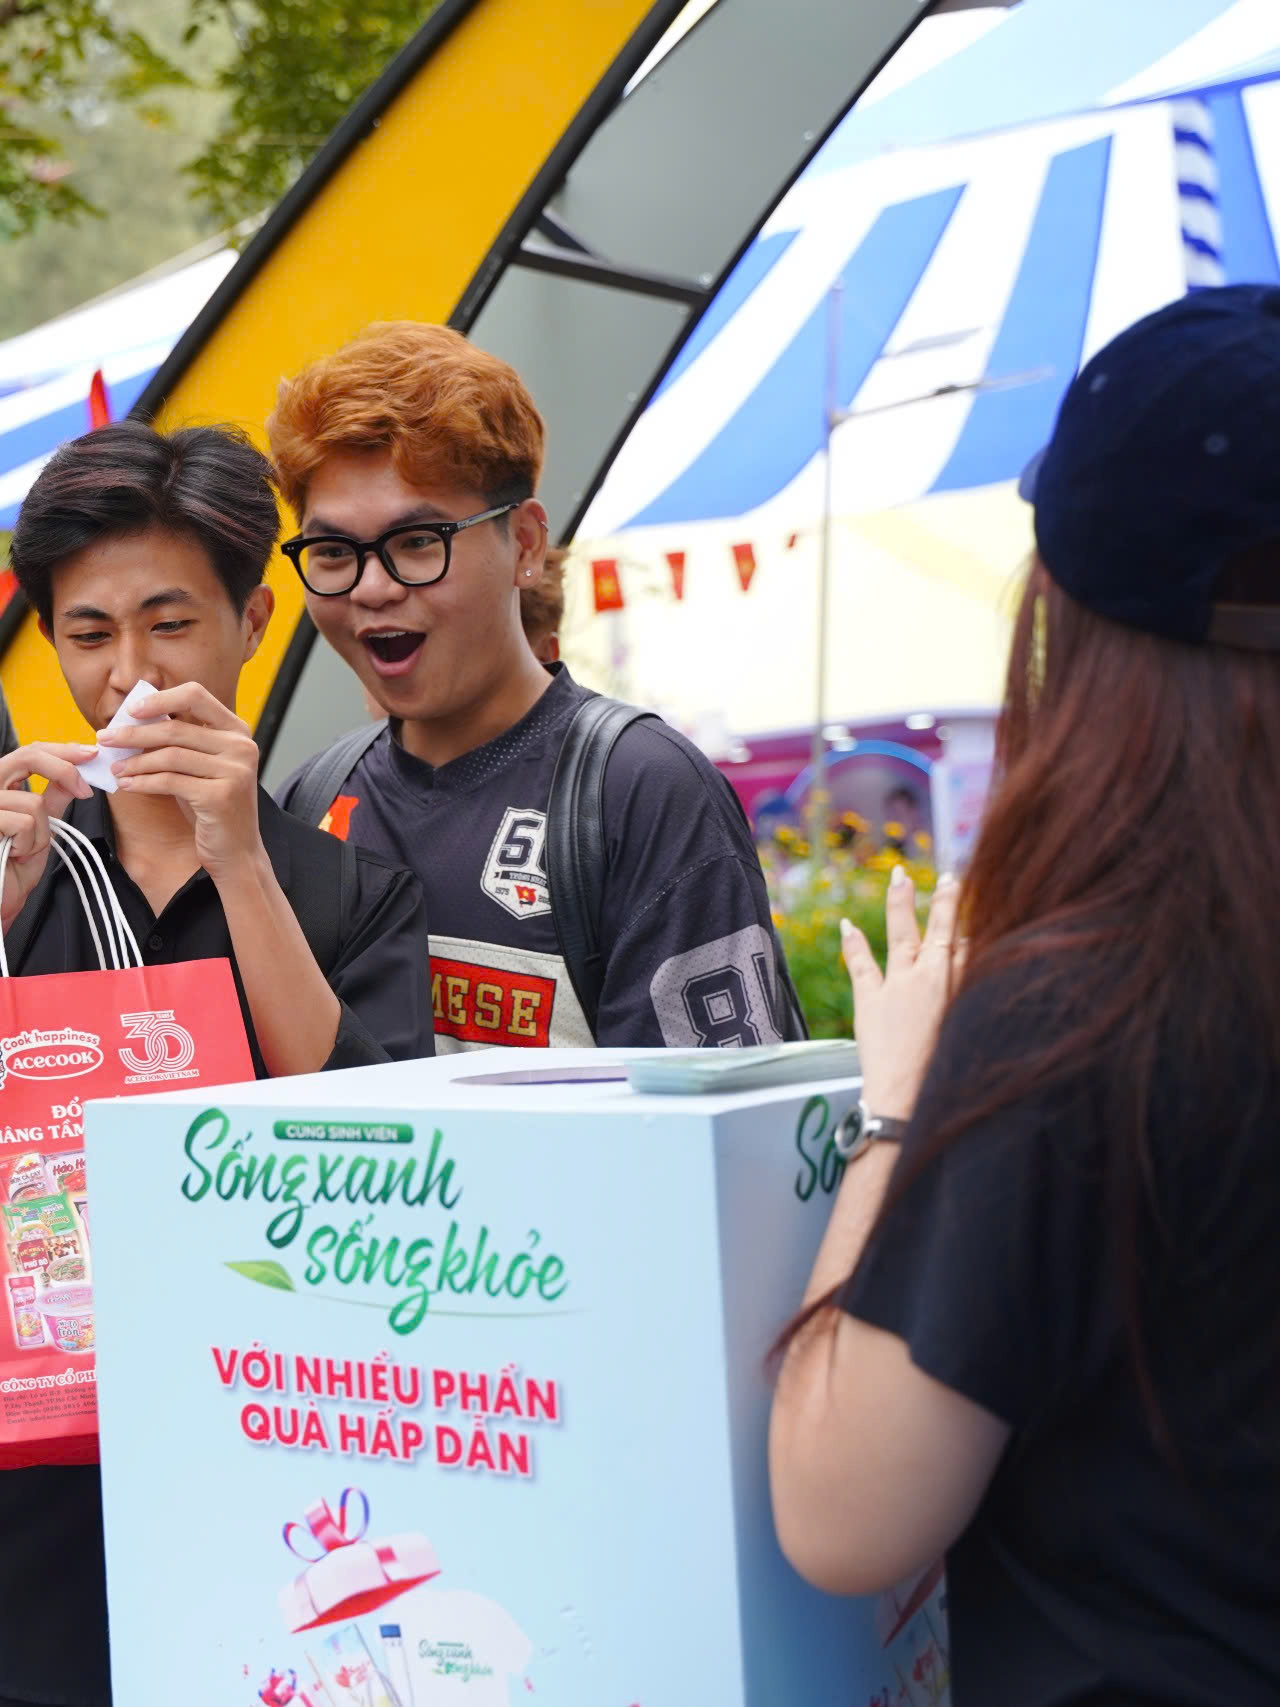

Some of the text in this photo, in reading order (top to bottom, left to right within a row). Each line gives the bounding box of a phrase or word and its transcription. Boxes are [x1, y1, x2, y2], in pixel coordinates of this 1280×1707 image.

[496, 817, 547, 873] 5
[3, 1030, 100, 1051] Cook happiness
[181, 1107, 464, 1249] Sống xanh
[77, 1371, 96, 1382] PH
[211, 1341, 557, 1421] VỚI NHIỀU PHẦN
[240, 1400, 530, 1475] QUÀ HẤP DẪN
